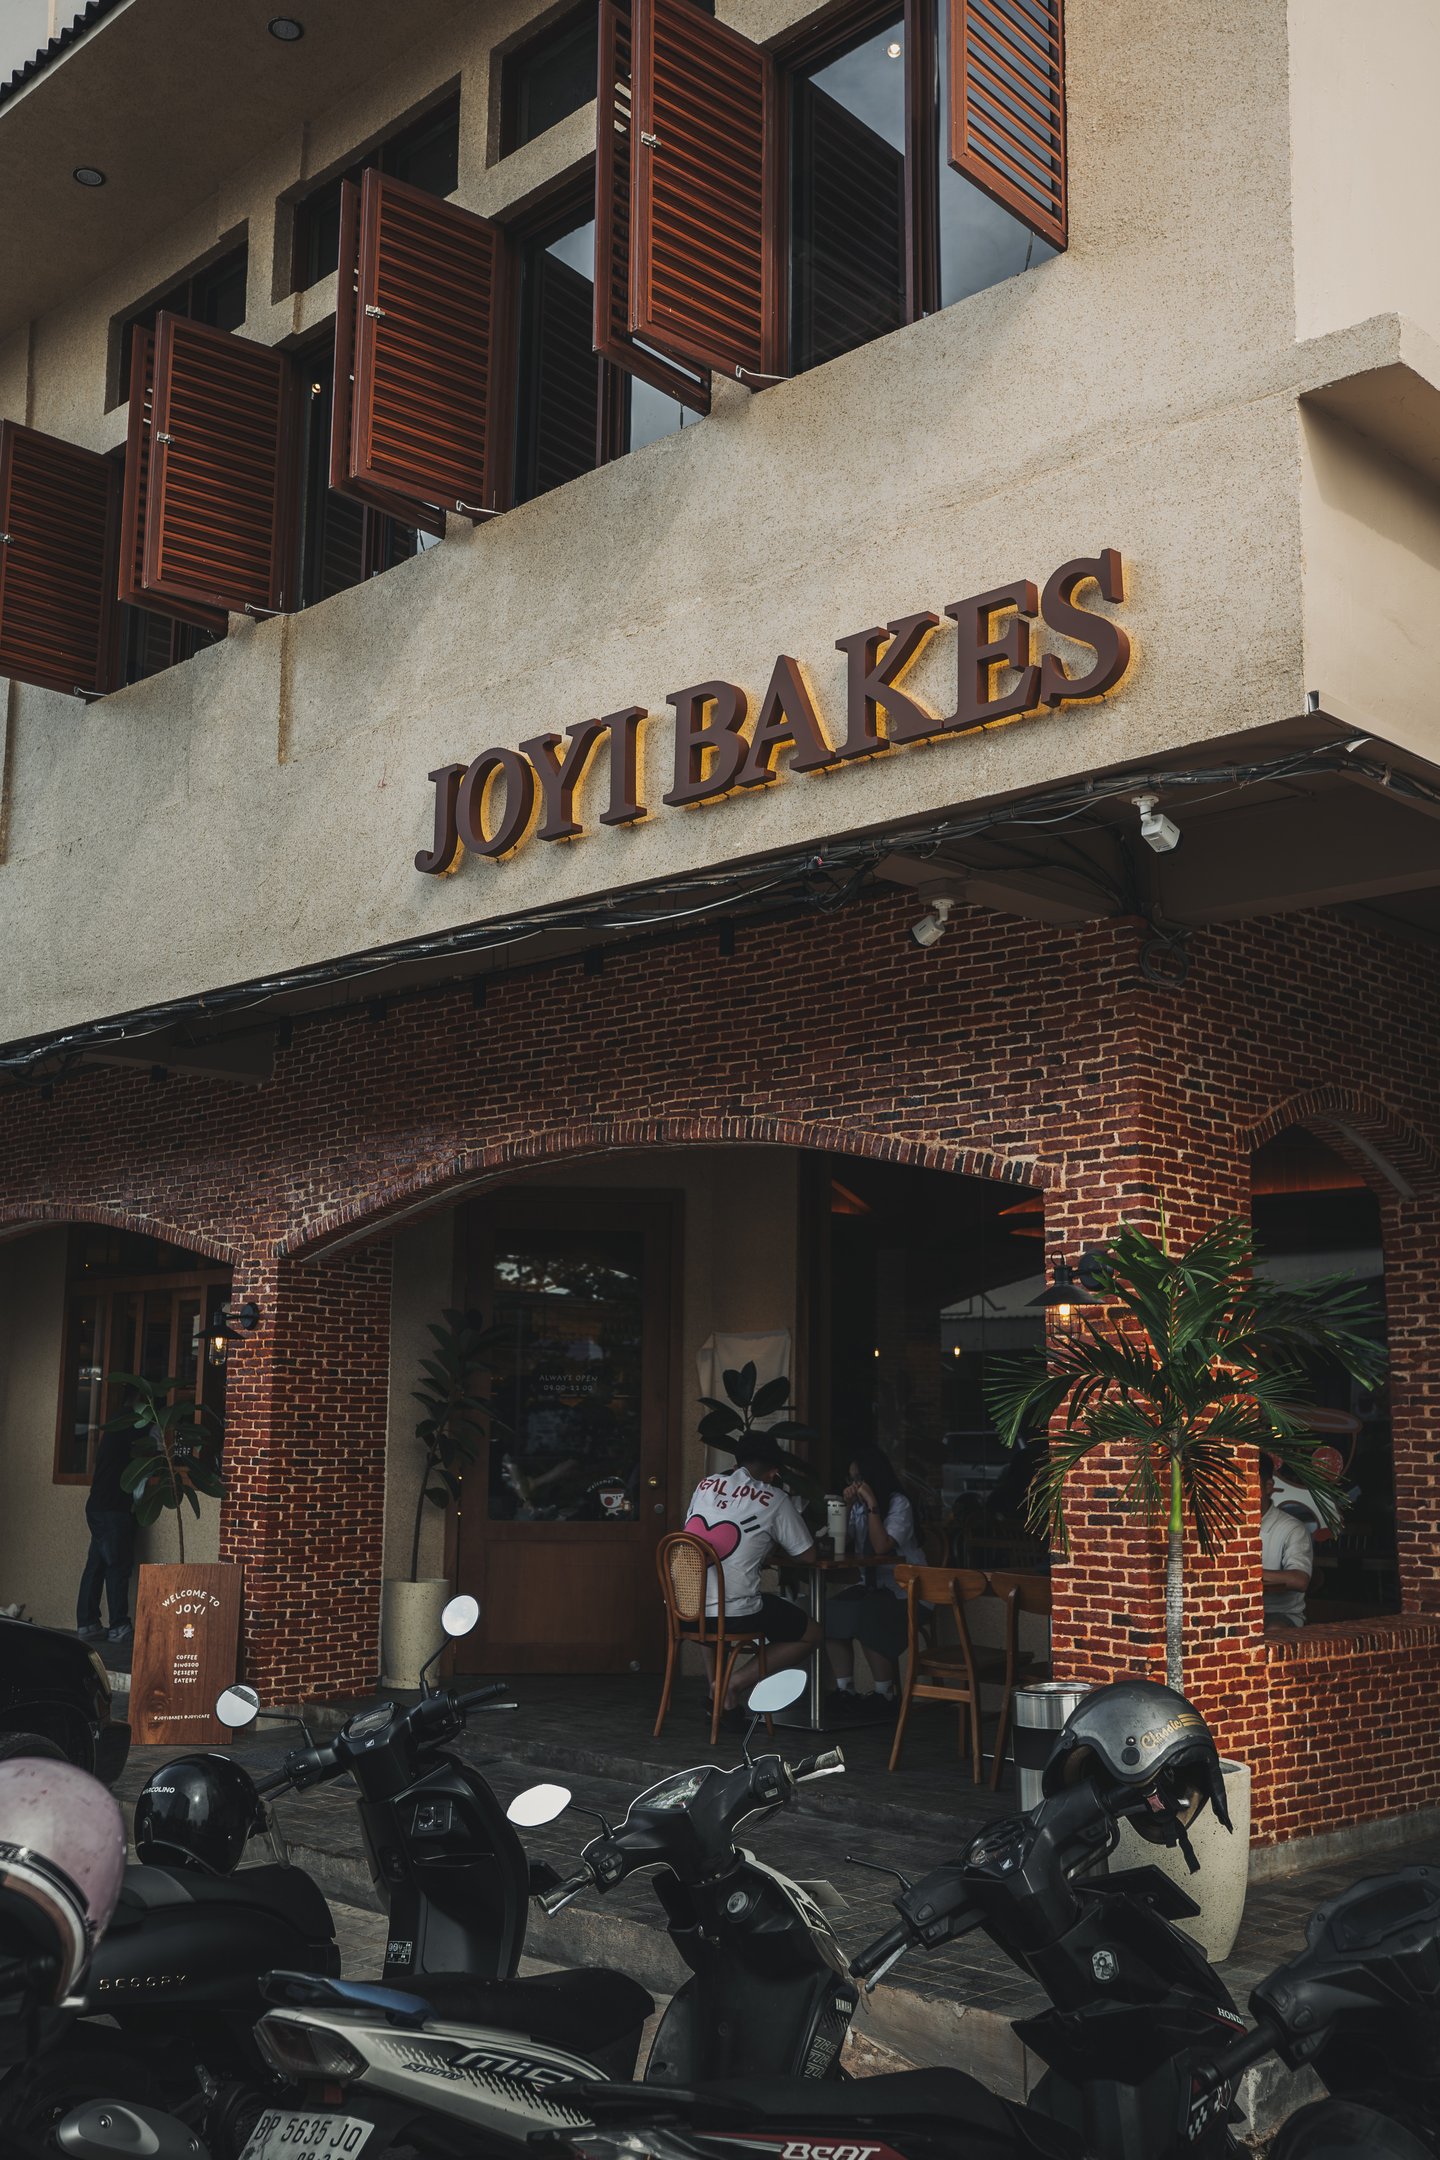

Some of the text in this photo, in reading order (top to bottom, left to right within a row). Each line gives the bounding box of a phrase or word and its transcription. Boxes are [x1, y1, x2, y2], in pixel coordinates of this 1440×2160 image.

[414, 548, 1131, 875] JOYI BAKES
[716, 1500, 728, 1509] IS
[731, 1485, 774, 1507] LOVE
[161, 1589, 220, 1607] WELCOME TO
[281, 2118, 332, 2146] 5635
